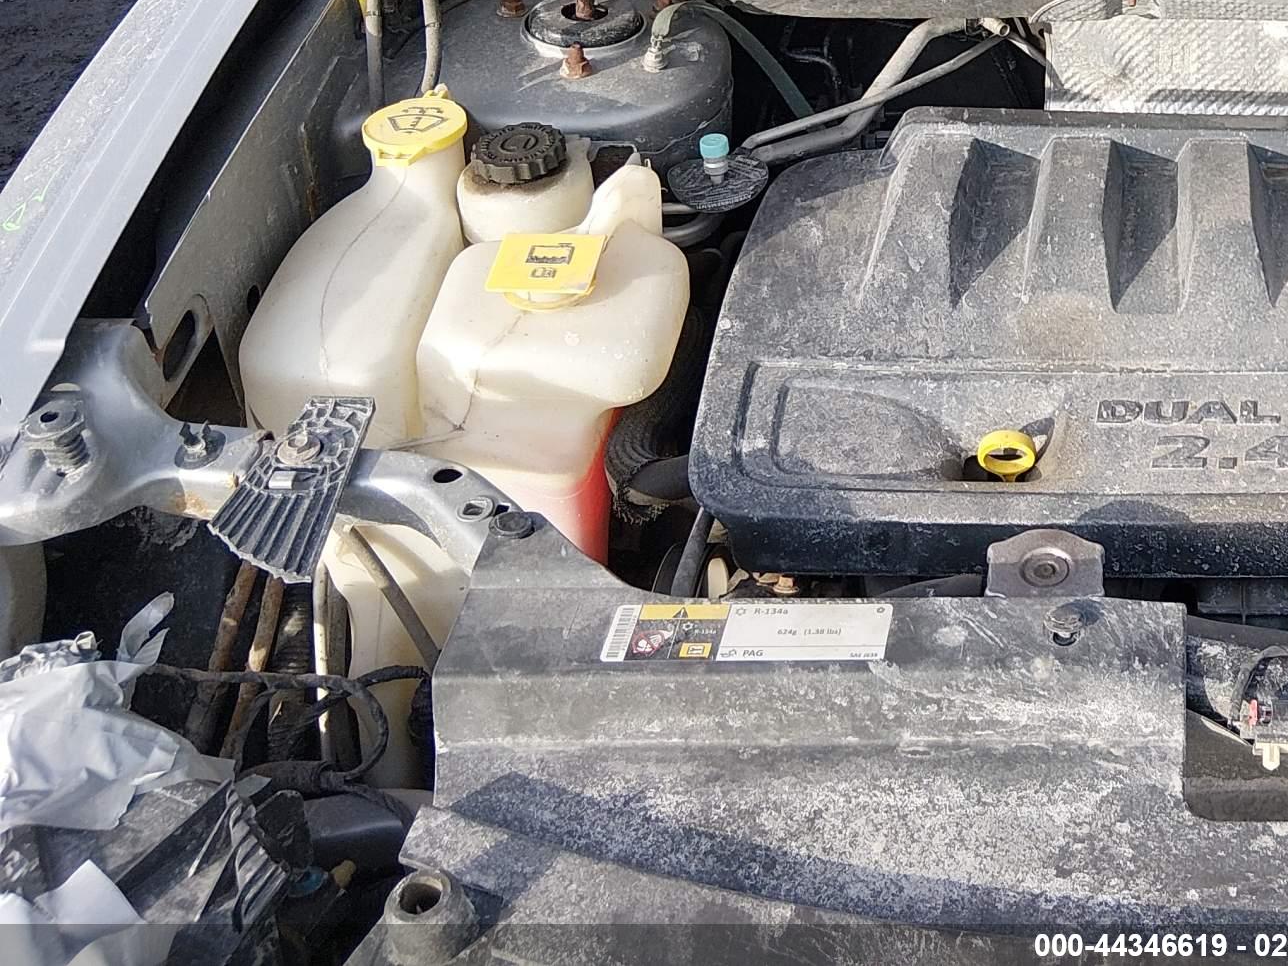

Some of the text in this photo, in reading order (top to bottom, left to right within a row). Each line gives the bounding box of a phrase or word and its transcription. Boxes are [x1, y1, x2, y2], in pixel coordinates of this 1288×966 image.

[1096, 399, 1281, 425] DUAL
[753, 607, 789, 616] R-134a
[776, 628, 797, 636] 624g
[742, 649, 764, 658] PAG
